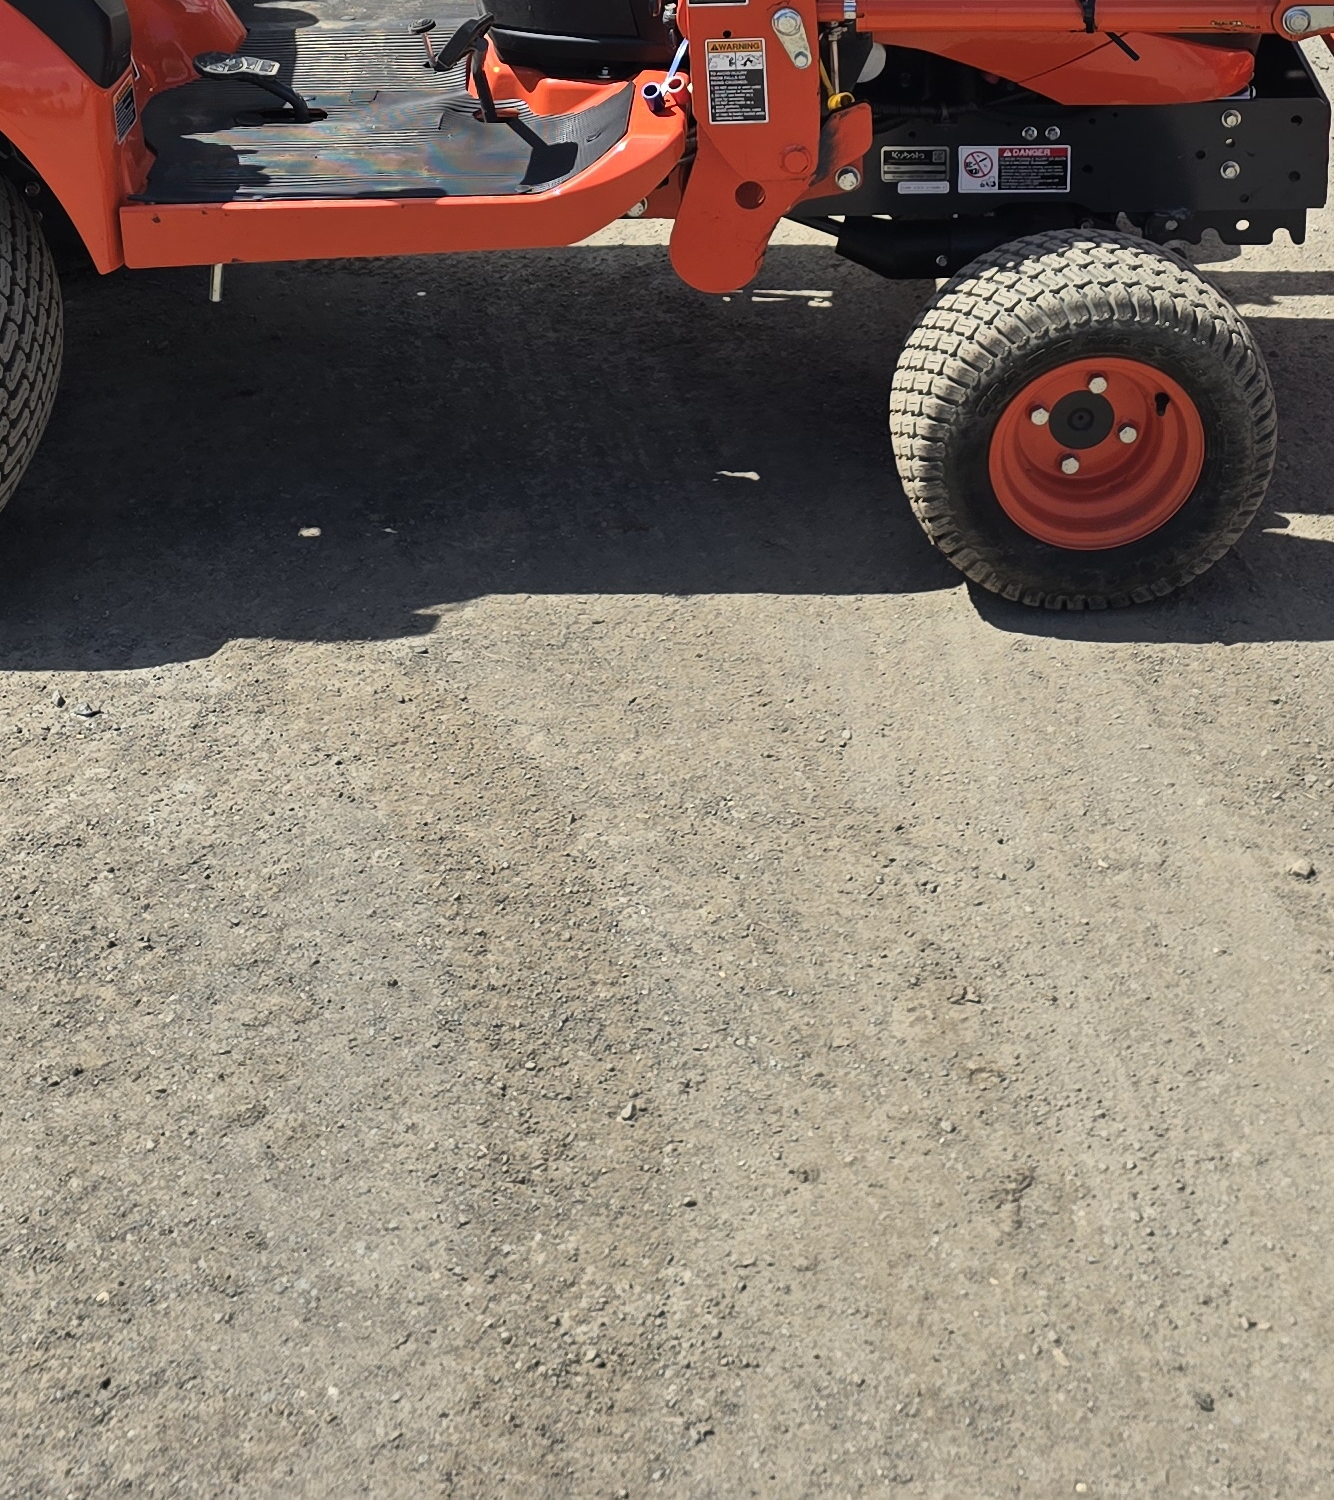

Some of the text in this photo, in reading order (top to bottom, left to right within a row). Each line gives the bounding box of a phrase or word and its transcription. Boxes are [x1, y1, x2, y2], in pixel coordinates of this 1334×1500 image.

[718, 42, 760, 51] WARNING
[892, 151, 925, 160] Kubota
[1012, 148, 1051, 157] DANGER
